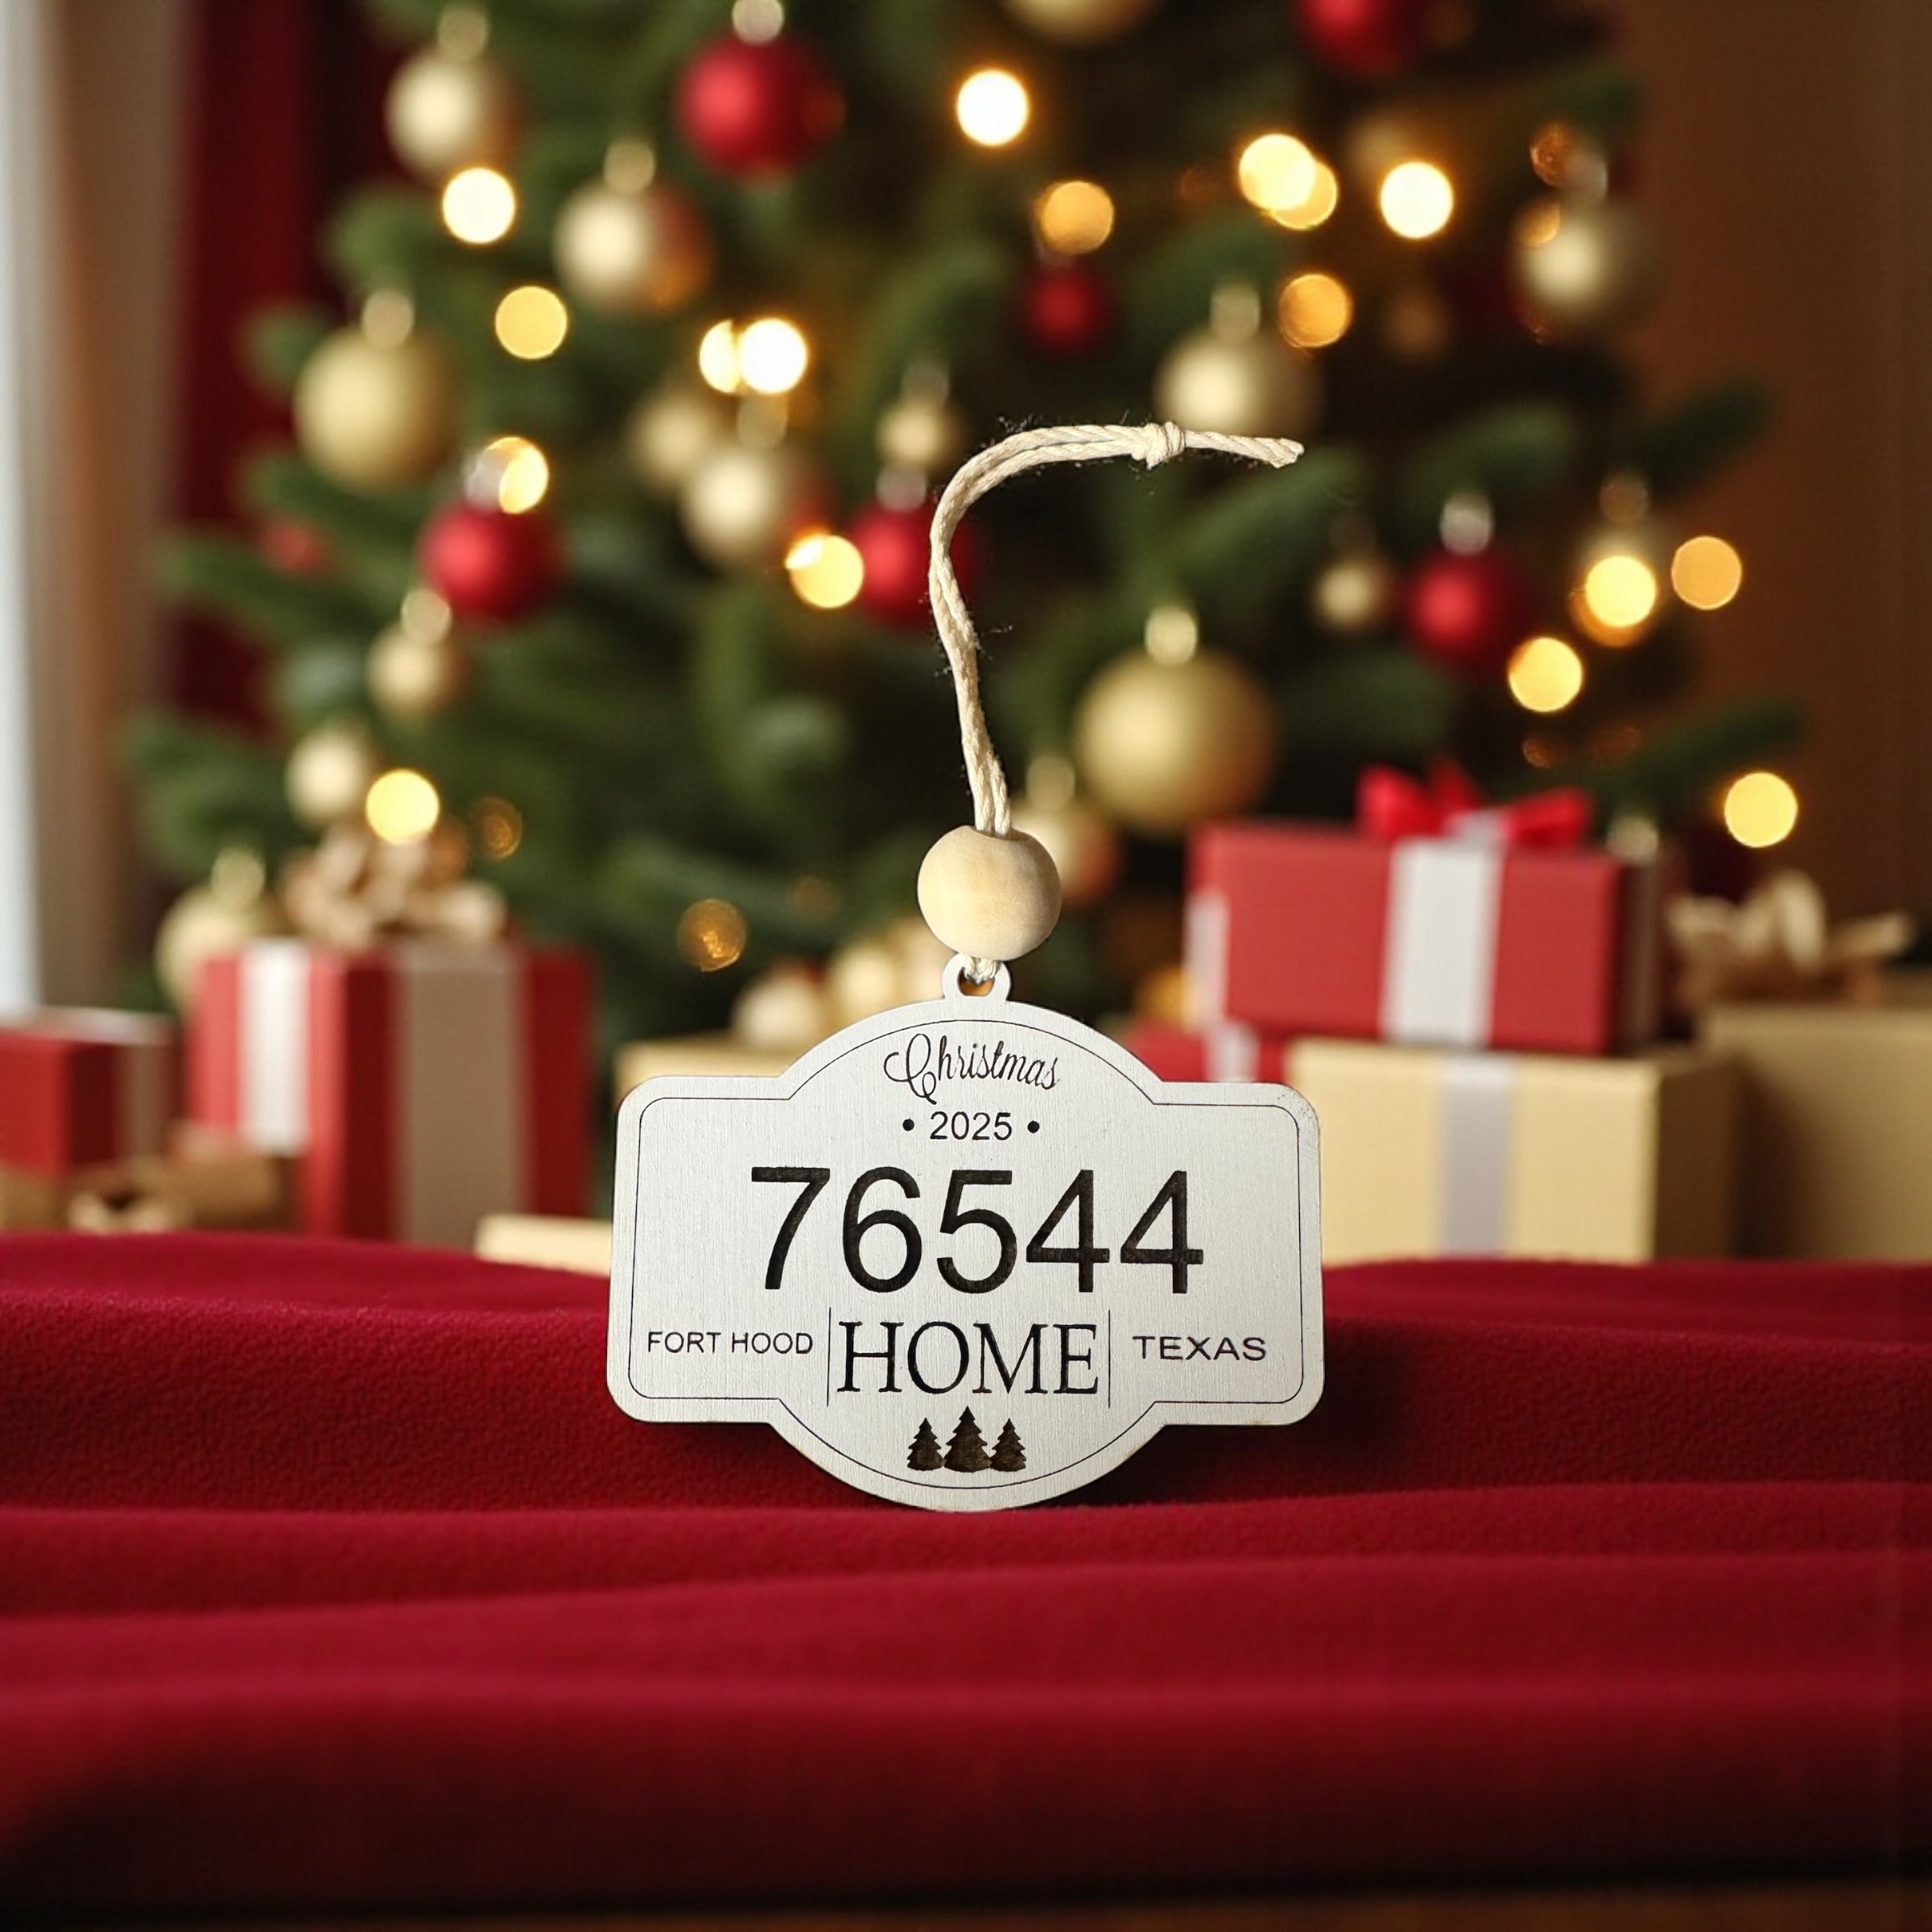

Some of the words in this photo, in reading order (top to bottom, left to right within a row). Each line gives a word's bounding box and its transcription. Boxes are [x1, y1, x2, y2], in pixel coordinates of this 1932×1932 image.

[883, 1033, 1058, 1104] Christmas
[929, 1111, 1013, 1141] 2025
[751, 1166, 1204, 1294] 76544
[647, 1331, 722, 1354] FORT
[731, 1331, 814, 1355] HOOD
[836, 1320, 1099, 1395] HOME
[1132, 1335, 1267, 1361] TEXAS
